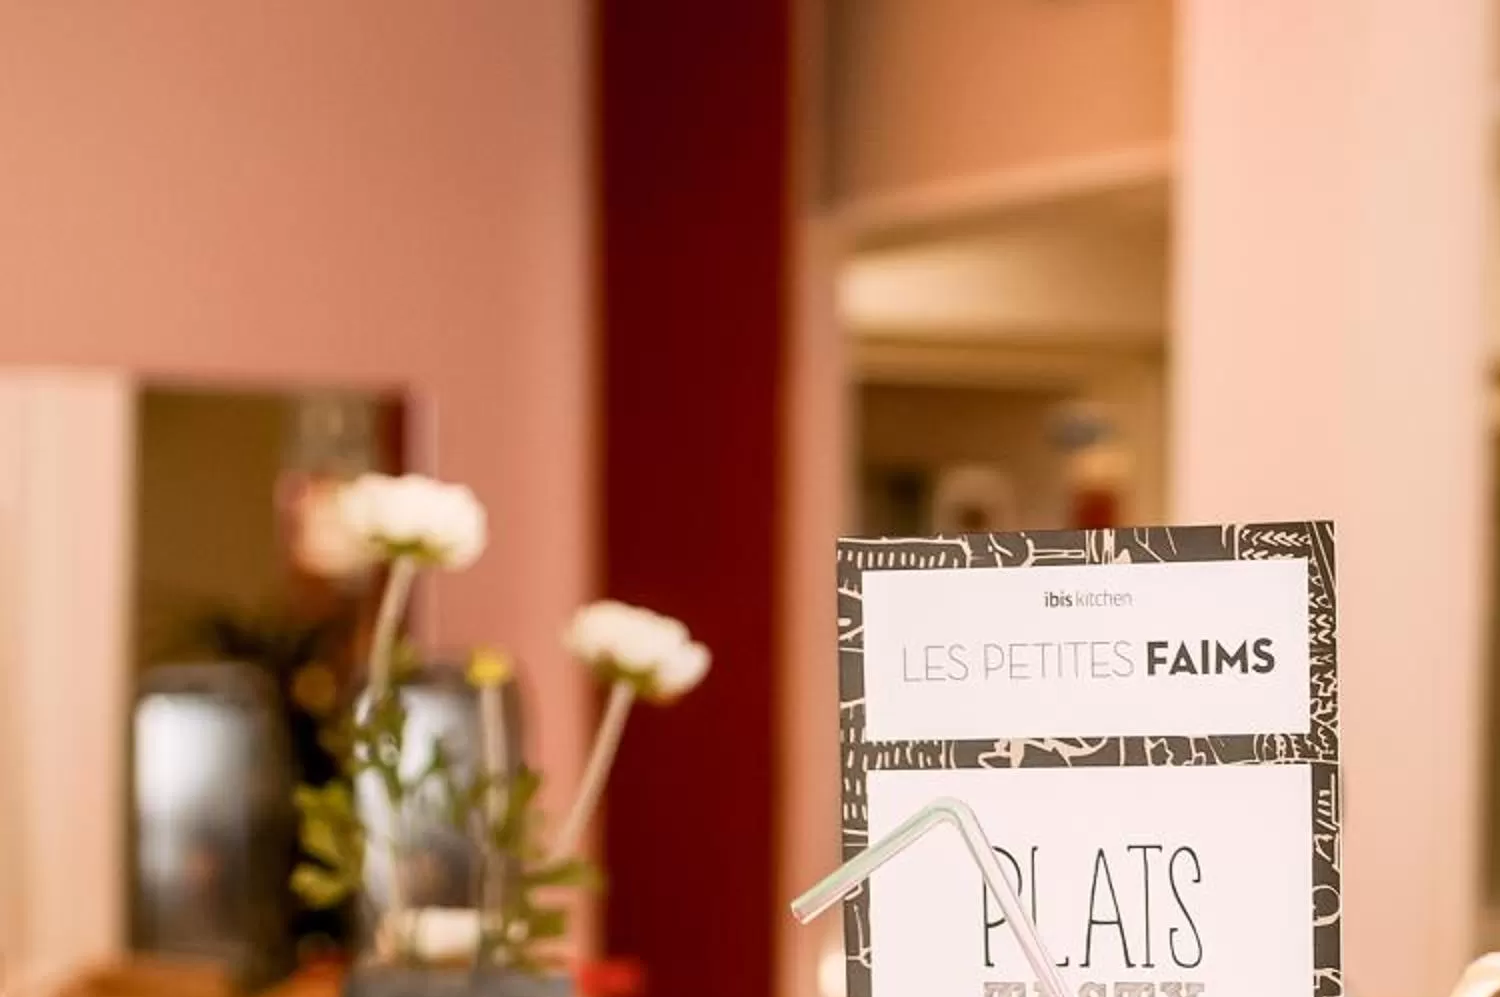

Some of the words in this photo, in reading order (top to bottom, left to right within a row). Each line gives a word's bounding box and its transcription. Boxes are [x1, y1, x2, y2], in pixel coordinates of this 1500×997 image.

[1044, 590, 1073, 608] ibis
[1075, 590, 1134, 608] kitchen
[902, 644, 969, 683] LES
[983, 640, 1135, 681] PETITES
[1147, 637, 1276, 677] FAIMS
